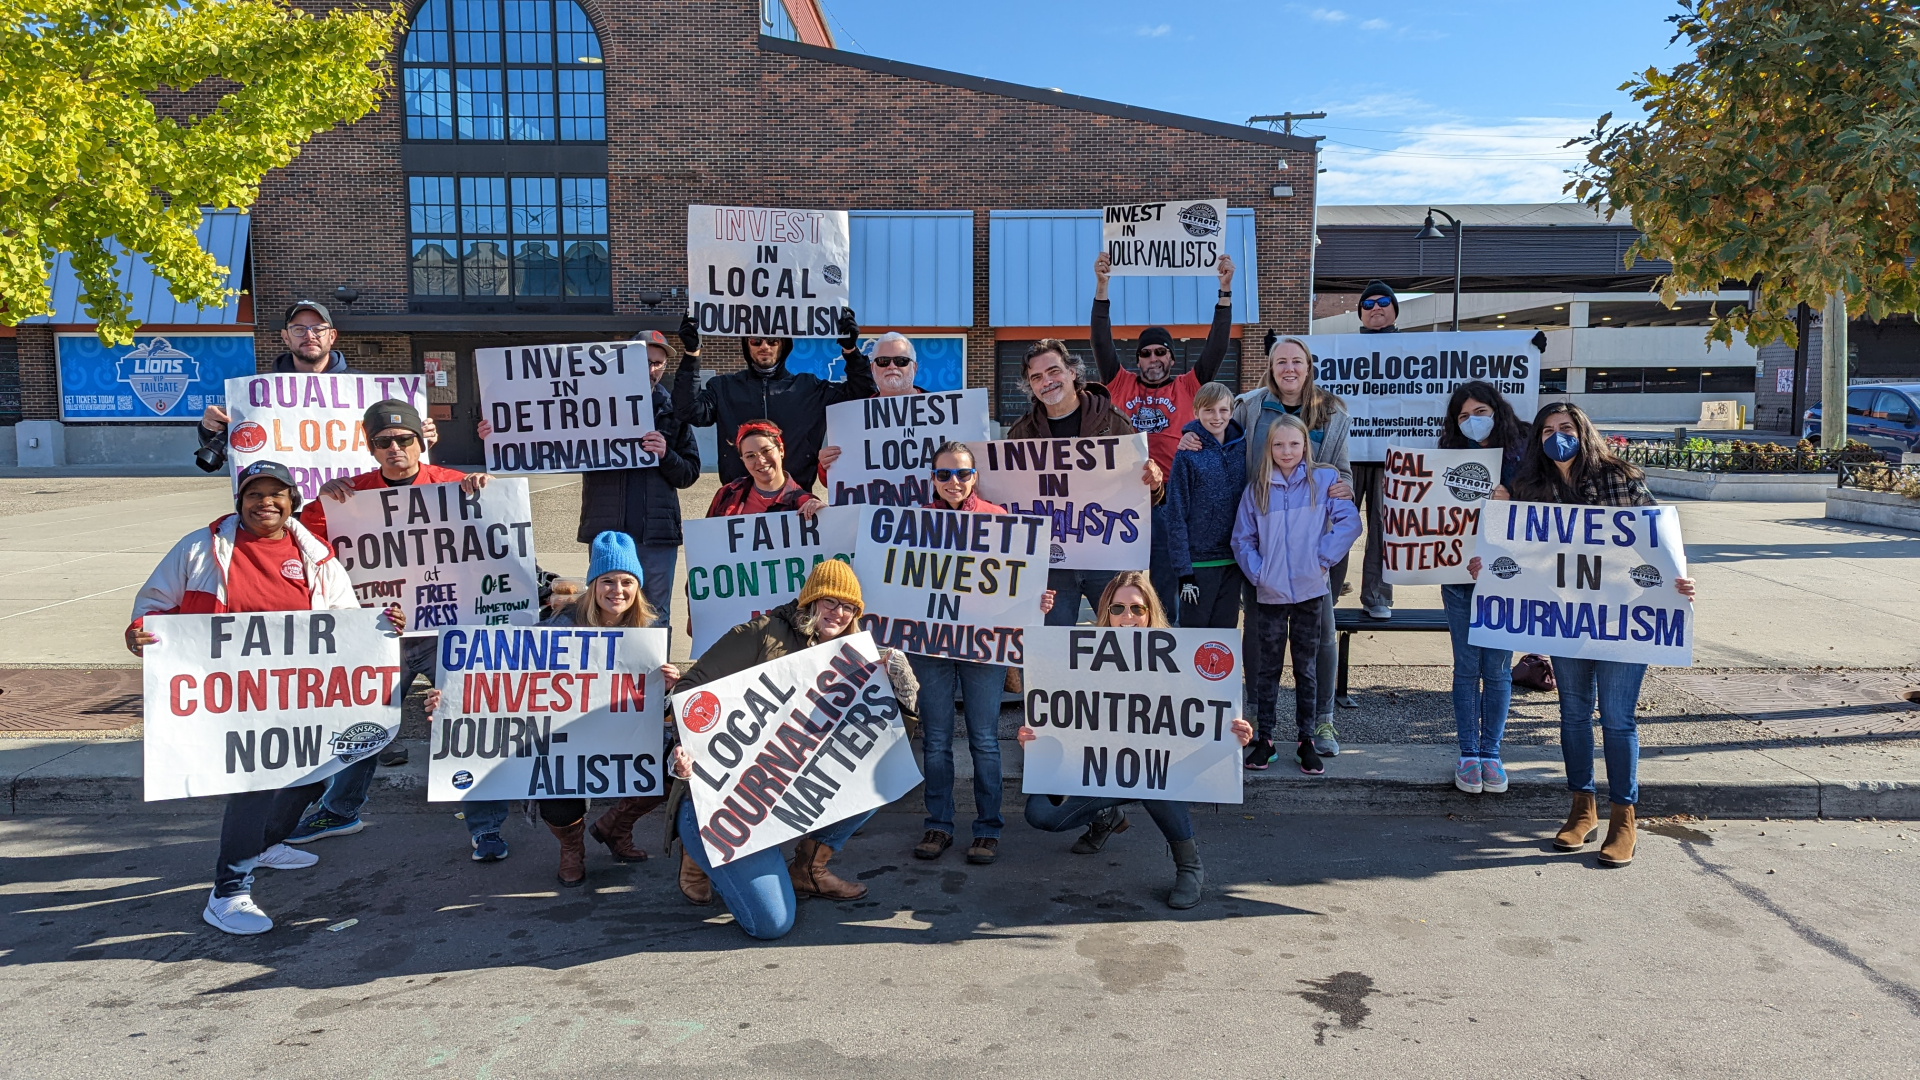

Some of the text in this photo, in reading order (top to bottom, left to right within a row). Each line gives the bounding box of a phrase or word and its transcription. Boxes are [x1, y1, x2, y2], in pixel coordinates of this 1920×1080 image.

[715, 208, 825, 244] INVEST
[1105, 203, 1166, 223] INVEST
[1182, 213, 1218, 227] DETROIT
[1122, 225, 1135, 237] IN
[757, 245, 778, 264] IN
[1108, 240, 1217, 268] JOURNALISTS
[708, 264, 817, 299] LOCAL
[504, 344, 627, 381] INVEST
[64, 395, 115, 404] GET TICKETS TODAY
[140, 382, 179, 393] TAILGATE
[205, 394, 215, 404] GET
[249, 375, 420, 409] QUALITY
[550, 379, 579, 398] IN
[1362, 381, 1423, 396] Depends
[1425, 381, 1444, 394] on
[491, 395, 643, 434] DETROIT
[863, 393, 963, 430] INVEST
[1371, 416, 1445, 427] NewsGuild-CW
[272, 418, 370, 452] LOCA
[902, 427, 915, 438] IN
[490, 437, 656, 472] JOURNALISTS
[986, 438, 1120, 471] INVEST
[1385, 448, 1433, 478] OCAL
[1038, 472, 1069, 498] IN
[1447, 475, 1491, 490] DETROIT
[380, 485, 483, 527] FAIR
[727, 513, 820, 553] FAIR
[870, 507, 1044, 555] GANNETT
[1506, 504, 1662, 548] INVEST
[336, 521, 532, 571] CONTRACT
[1383, 538, 1463, 571] ATTERS
[424, 565, 441, 582] at
[883, 548, 1026, 597] INVEST
[1556, 553, 1602, 591] IN
[415, 582, 458, 605] FREE
[474, 596, 530, 615] HOMETOWN
[926, 592, 961, 621] IN
[414, 603, 458, 630] PRESS
[485, 614, 509, 626] LIFE
[1469, 594, 1685, 647] JOURNALISM
[210, 613, 337, 659] FAIR
[441, 629, 624, 672] GANNETT
[860, 613, 1024, 664] OURNALISTS
[1069, 630, 1181, 673] FAIR
[169, 665, 401, 717] CONTRACT
[462, 672, 598, 714] INVEST
[609, 673, 646, 713] IN
[692, 671, 797, 792] LOCAL
[1027, 688, 1232, 742] CONTRACT
[225, 724, 323, 774] NOW
[432, 715, 568, 761] JOURN-
[700, 642, 878, 863] JOURNALISM
[527, 753, 656, 796] ALISTS
[771, 684, 899, 834] MATTERS
[1082, 746, 1171, 790] NOW
